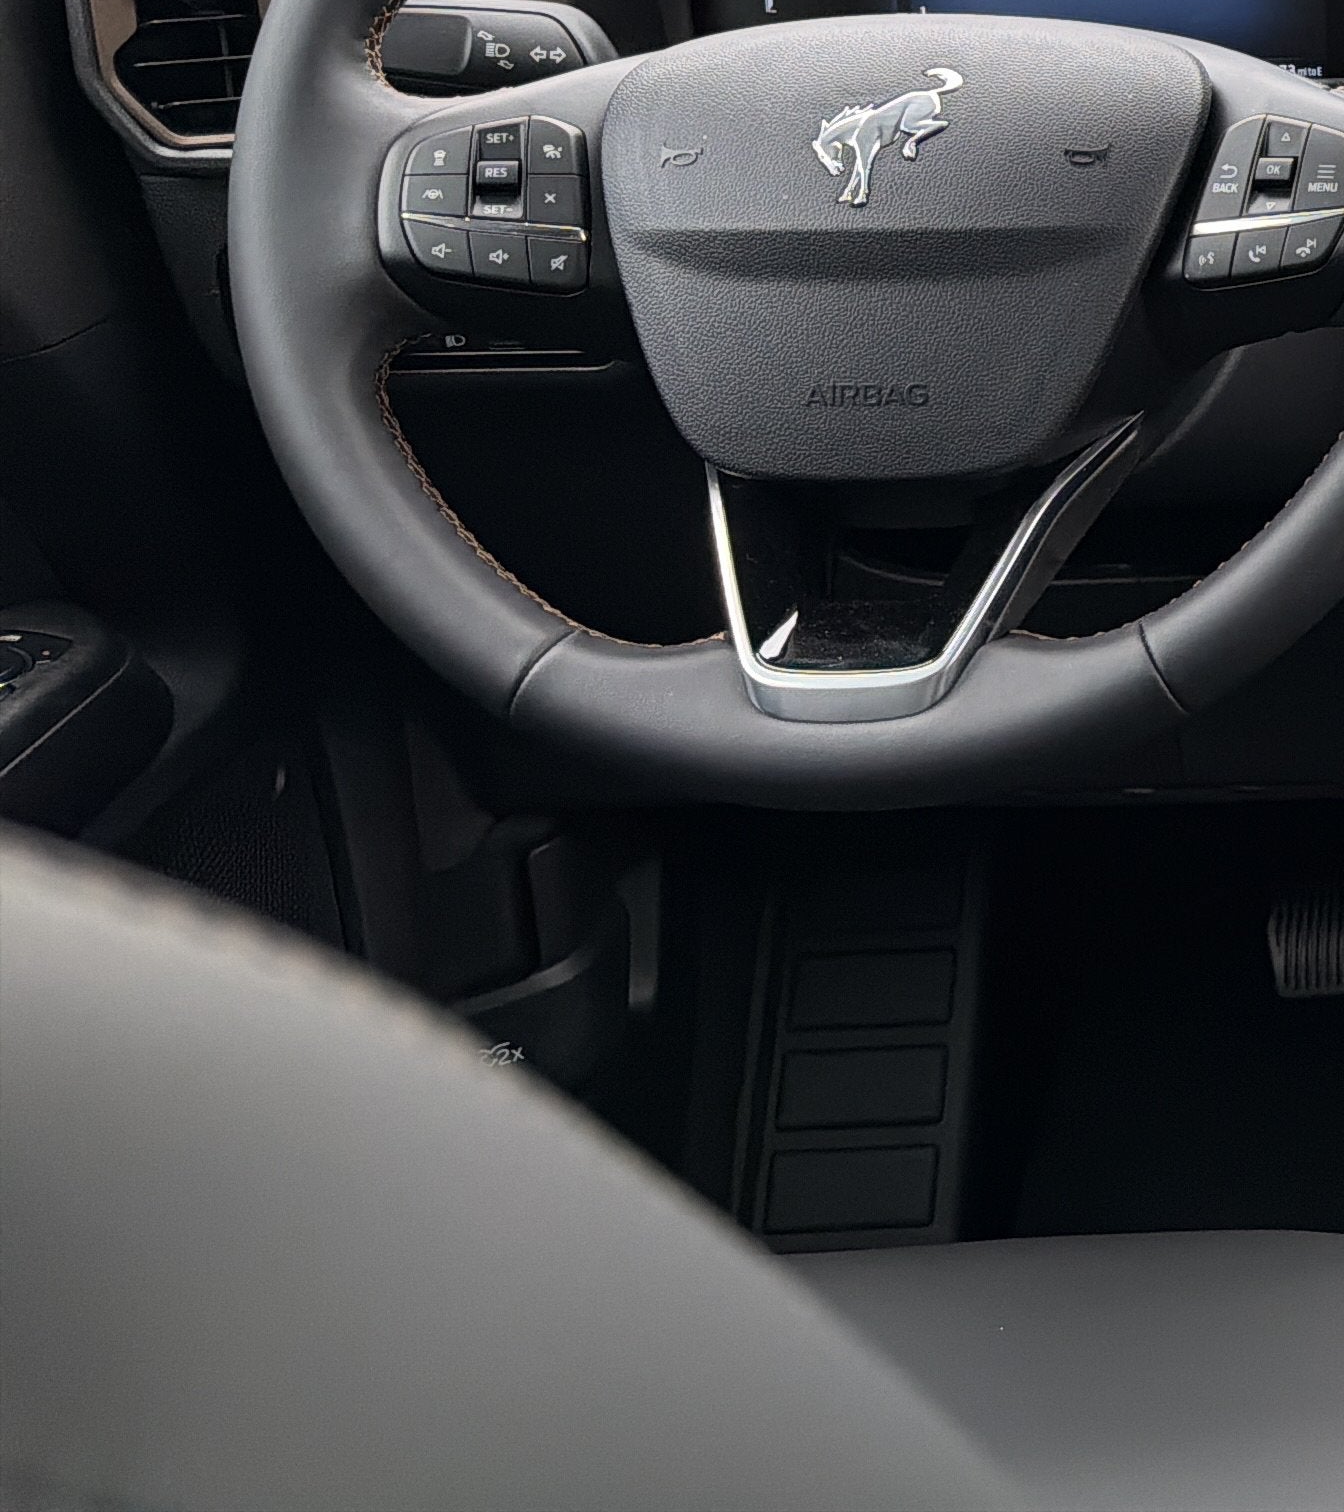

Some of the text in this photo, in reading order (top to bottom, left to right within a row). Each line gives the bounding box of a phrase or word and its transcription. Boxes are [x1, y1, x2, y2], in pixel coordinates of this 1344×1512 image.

[484, 167, 508, 179] RES
[1266, 165, 1281, 175] OK
[1212, 182, 1239, 194] BACK
[1307, 182, 1339, 192] MENU
[804, 383, 930, 408] AIRBAG
